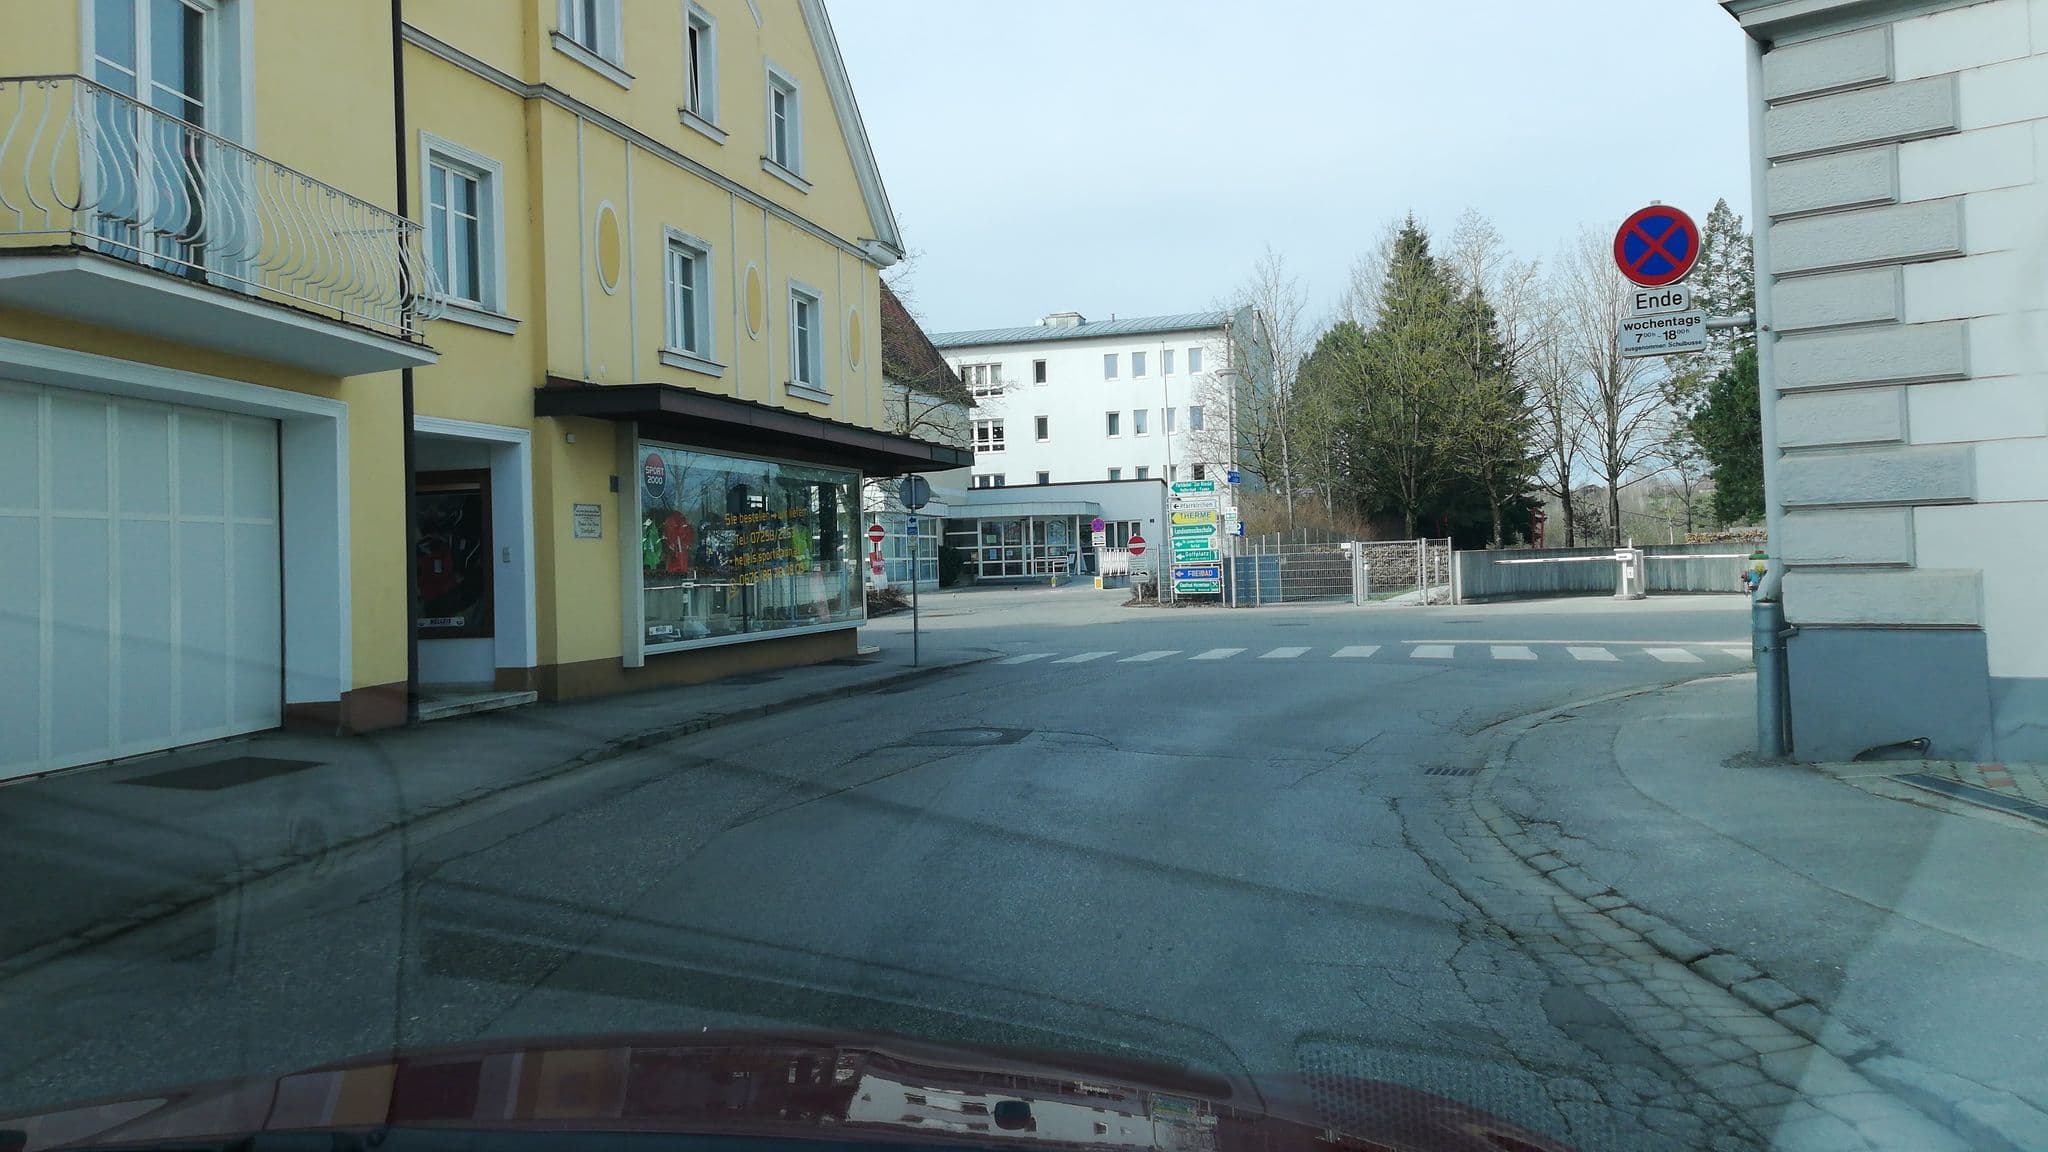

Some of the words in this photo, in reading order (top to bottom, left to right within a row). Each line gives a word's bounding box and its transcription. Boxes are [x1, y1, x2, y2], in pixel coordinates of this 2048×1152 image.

[1636, 291, 1682, 310] Ende
[1624, 316, 1701, 331] wochentags
[1624, 343, 1667, 352] ausgenommen
[1668, 339, 1702, 348] Schulbusse
[645, 466, 664, 476] SPORT
[647, 475, 663, 485] 2000
[725, 513, 737, 525] Sie
[740, 511, 769, 523] bestellen
[1180, 511, 1211, 519] THERME
[1187, 569, 1213, 577] FREIBAD
